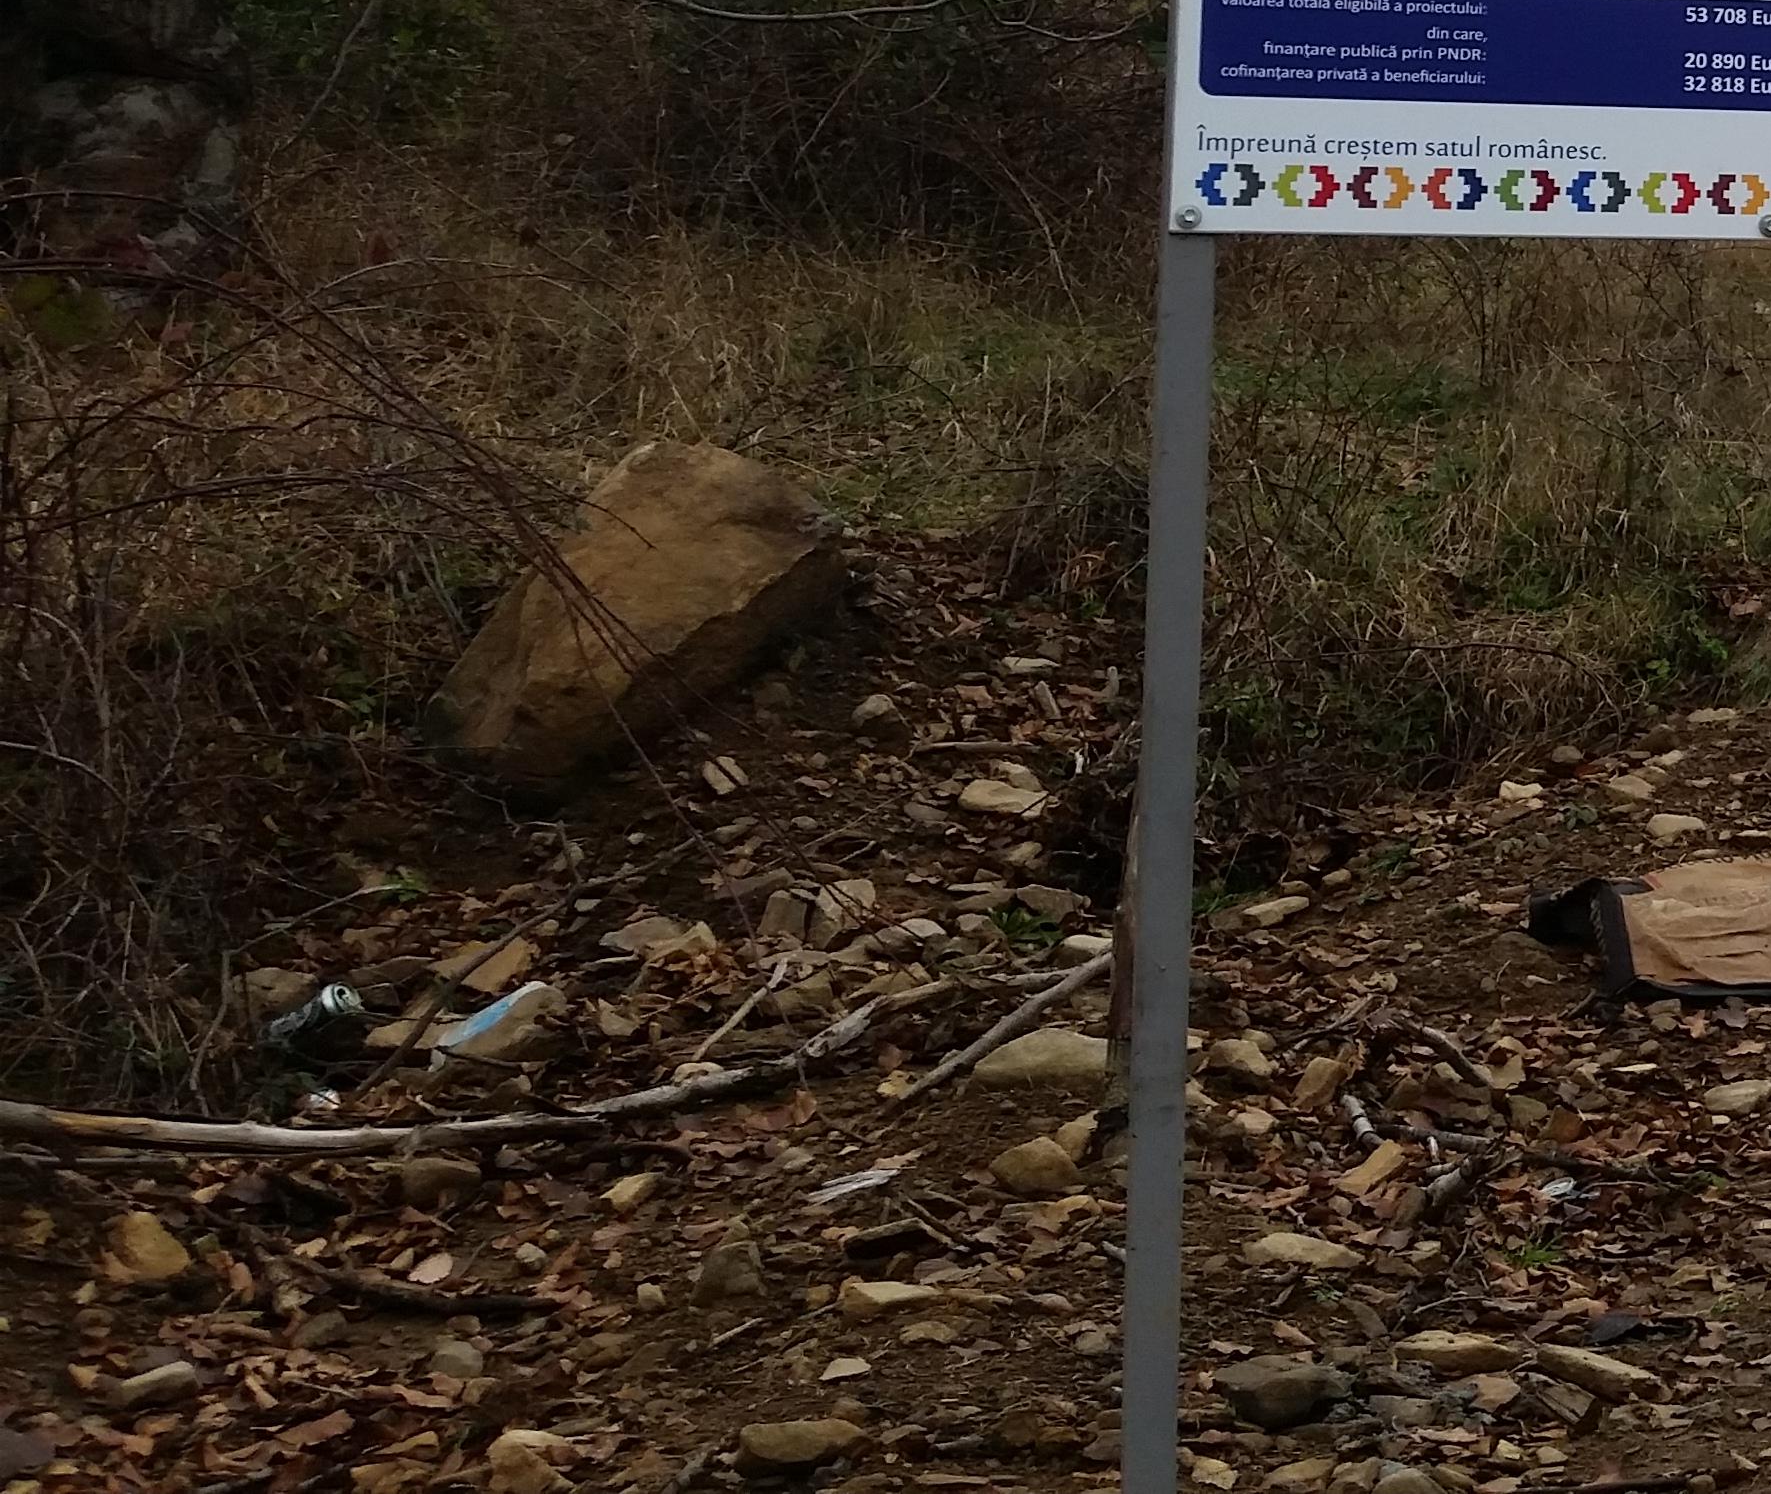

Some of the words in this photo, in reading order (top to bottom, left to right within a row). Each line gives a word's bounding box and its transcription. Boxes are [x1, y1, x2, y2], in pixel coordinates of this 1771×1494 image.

[1393, 1, 1403, 12] a
[1406, 0, 1487, 15] proiectului:
[1685, 6, 1709, 23] 53
[1713, 7, 1747, 25] 708
[1426, 26, 1450, 40] din
[1452, 30, 1488, 43] care,
[1340, 44, 1397, 59] publică
[1401, 46, 1433, 62] prin
[1437, 47, 1487, 61] PNDR:
[1684, 52, 1708, 69] 20
[1711, 53, 1746, 70] 890
[1317, 67, 1368, 82] privată
[1371, 71, 1380, 81] a
[1383, 68, 1486, 85] beneficiarului:
[1683, 75, 1707, 92] 32
[1710, 76, 1745, 93] 818
[1196, 124, 1317, 160] Împreună
[1424, 135, 1481, 157] satul
[1488, 138, 1607, 160] românesc.
